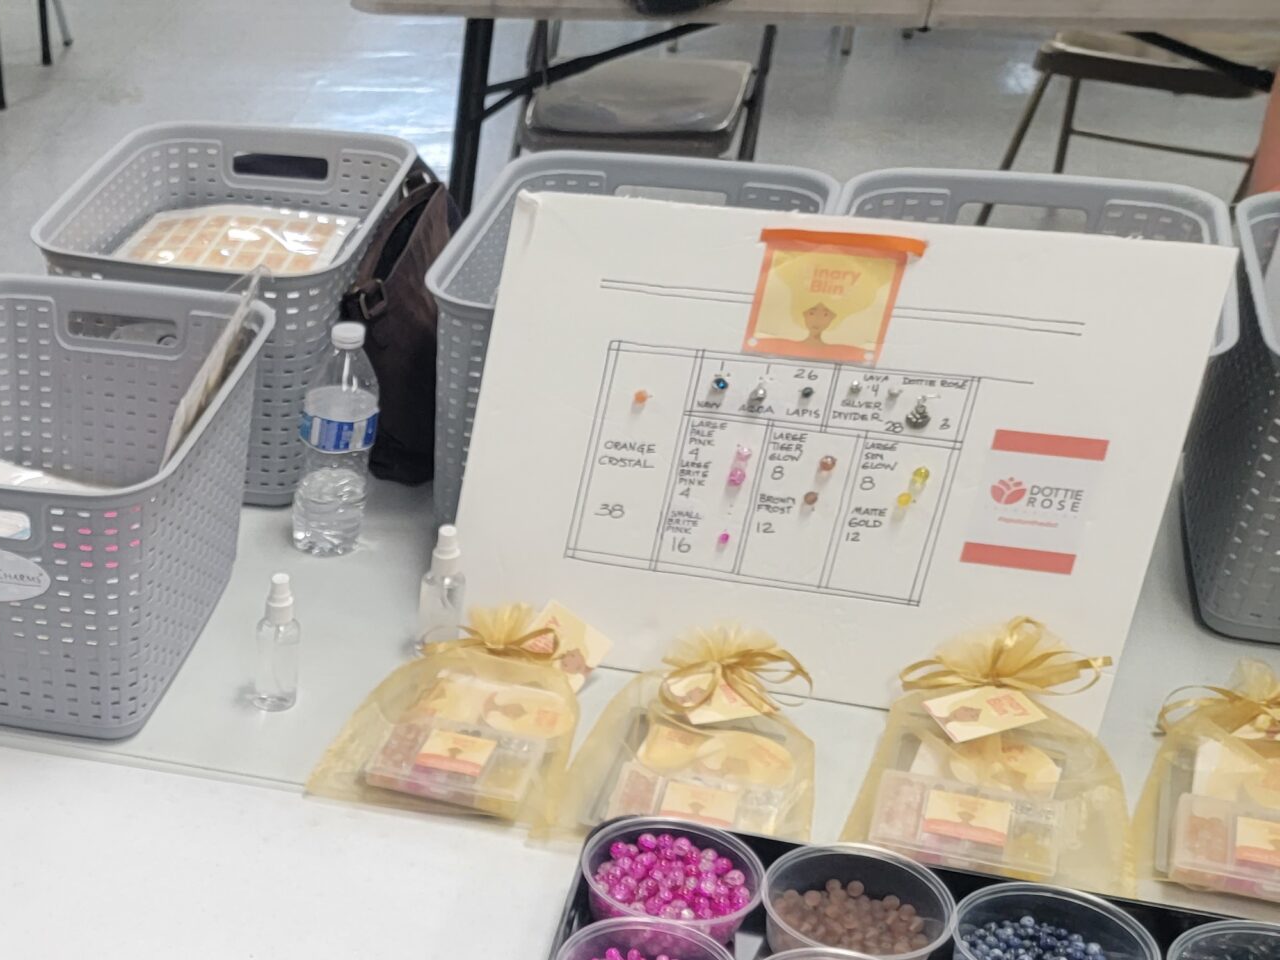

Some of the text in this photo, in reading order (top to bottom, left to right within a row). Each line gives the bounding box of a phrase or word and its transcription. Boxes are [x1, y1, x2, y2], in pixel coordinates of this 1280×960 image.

[793, 368, 818, 381] 26
[863, 374, 890, 382] LAVA
[902, 377, 936, 387] DOTTIE
[870, 384, 880, 397] 4
[840, 400, 883, 411] SILVER
[785, 408, 821, 419] LAPIS
[832, 410, 883, 422] DIVIDER
[884, 421, 905, 434] 28
[604, 440, 657, 455] ORANGE
[688, 437, 715, 447] PINK
[688, 448, 699, 461] 4
[598, 455, 656, 469] CRYSTAL
[861, 461, 898, 471] GLOW
[770, 465, 784, 481] 8
[678, 477, 705, 487] PINK
[859, 475, 876, 491] 8
[678, 487, 690, 499] 4
[1030, 485, 1084, 500] DOTTIE
[756, 503, 793, 514] FROST
[1026, 496, 1081, 513] ROSE
[593, 503, 625, 519] 38
[851, 507, 888, 517] MATTE
[756, 521, 776, 534] 12
[847, 517, 883, 528] GOLD
[845, 531, 861, 542] 12
[671, 536, 691, 554] 16
